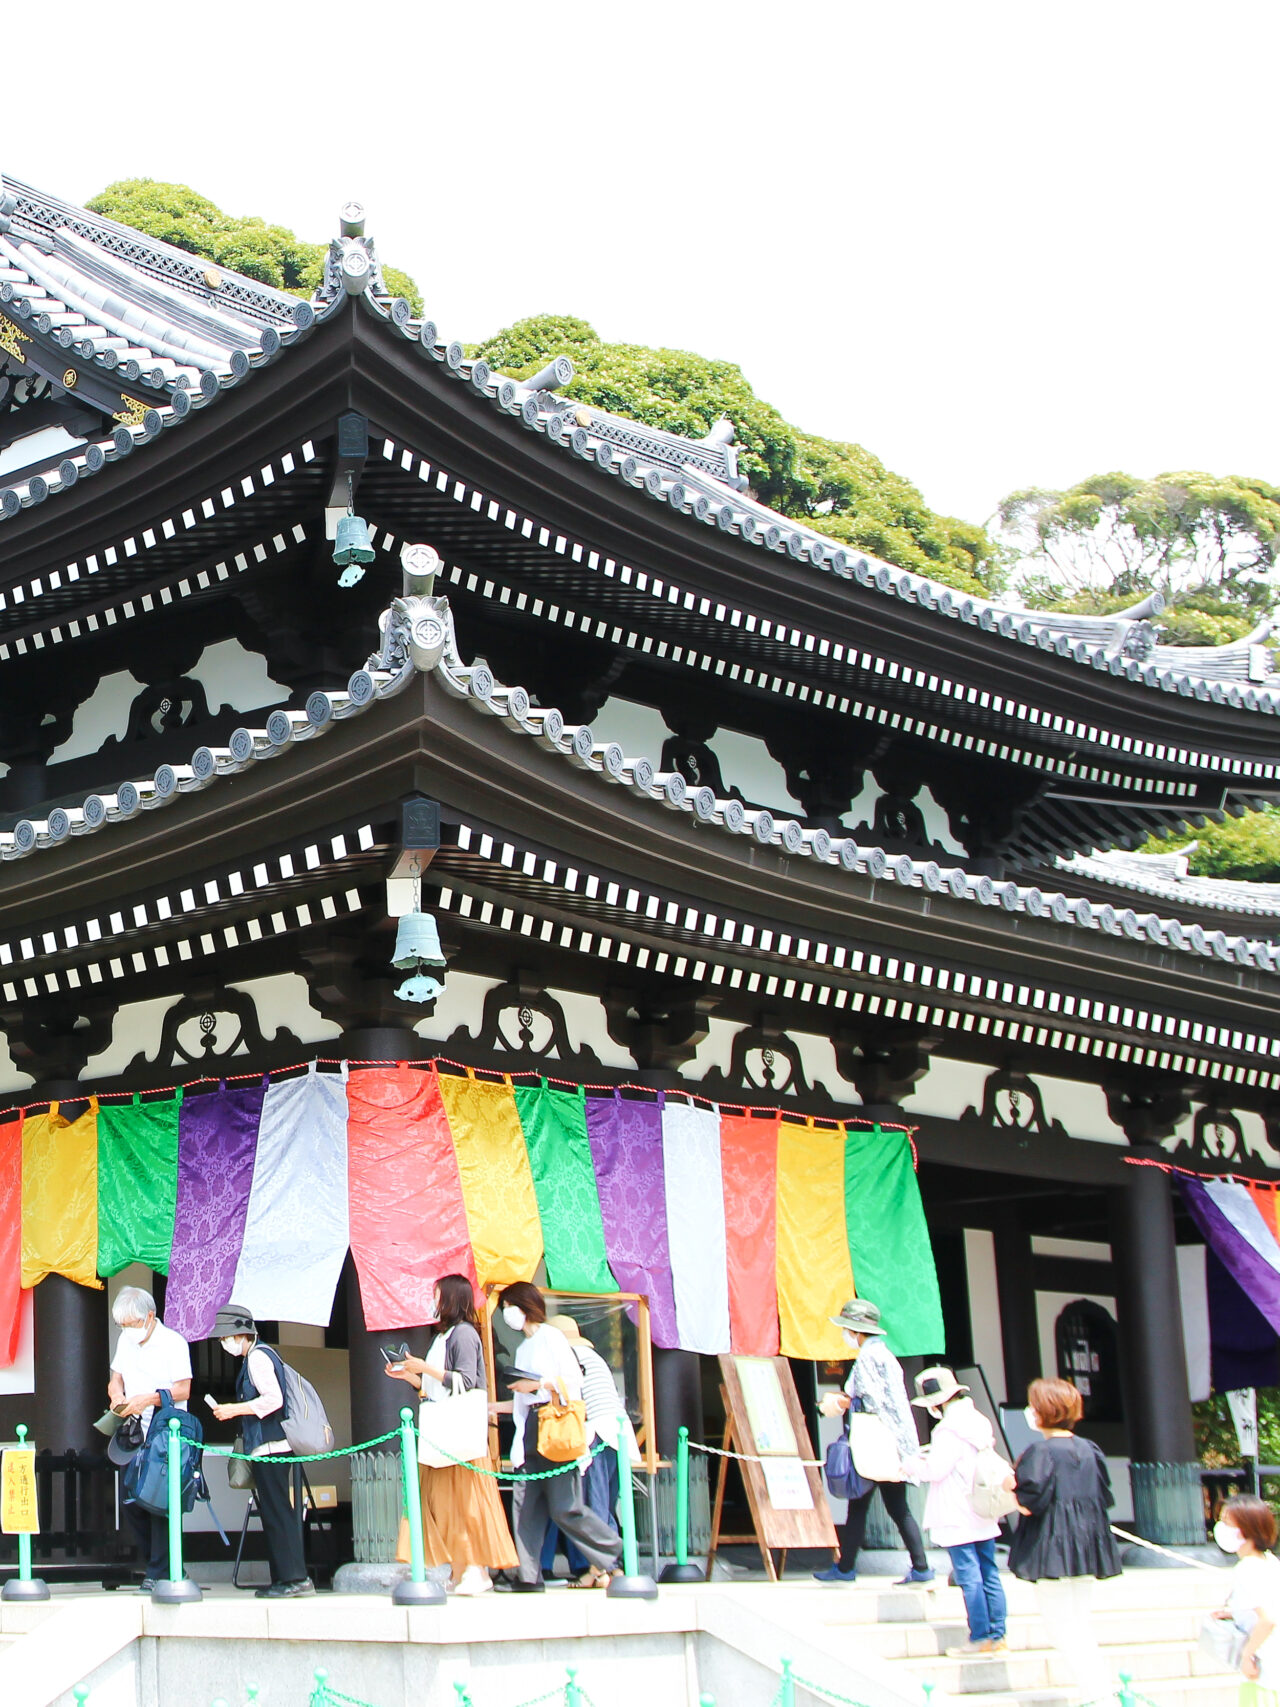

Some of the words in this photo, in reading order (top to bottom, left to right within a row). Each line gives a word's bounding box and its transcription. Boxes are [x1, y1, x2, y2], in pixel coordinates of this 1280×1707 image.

[8, 1462, 16, 1515] 進入禁止
[18, 1456, 29, 1516] 一方通行出口
